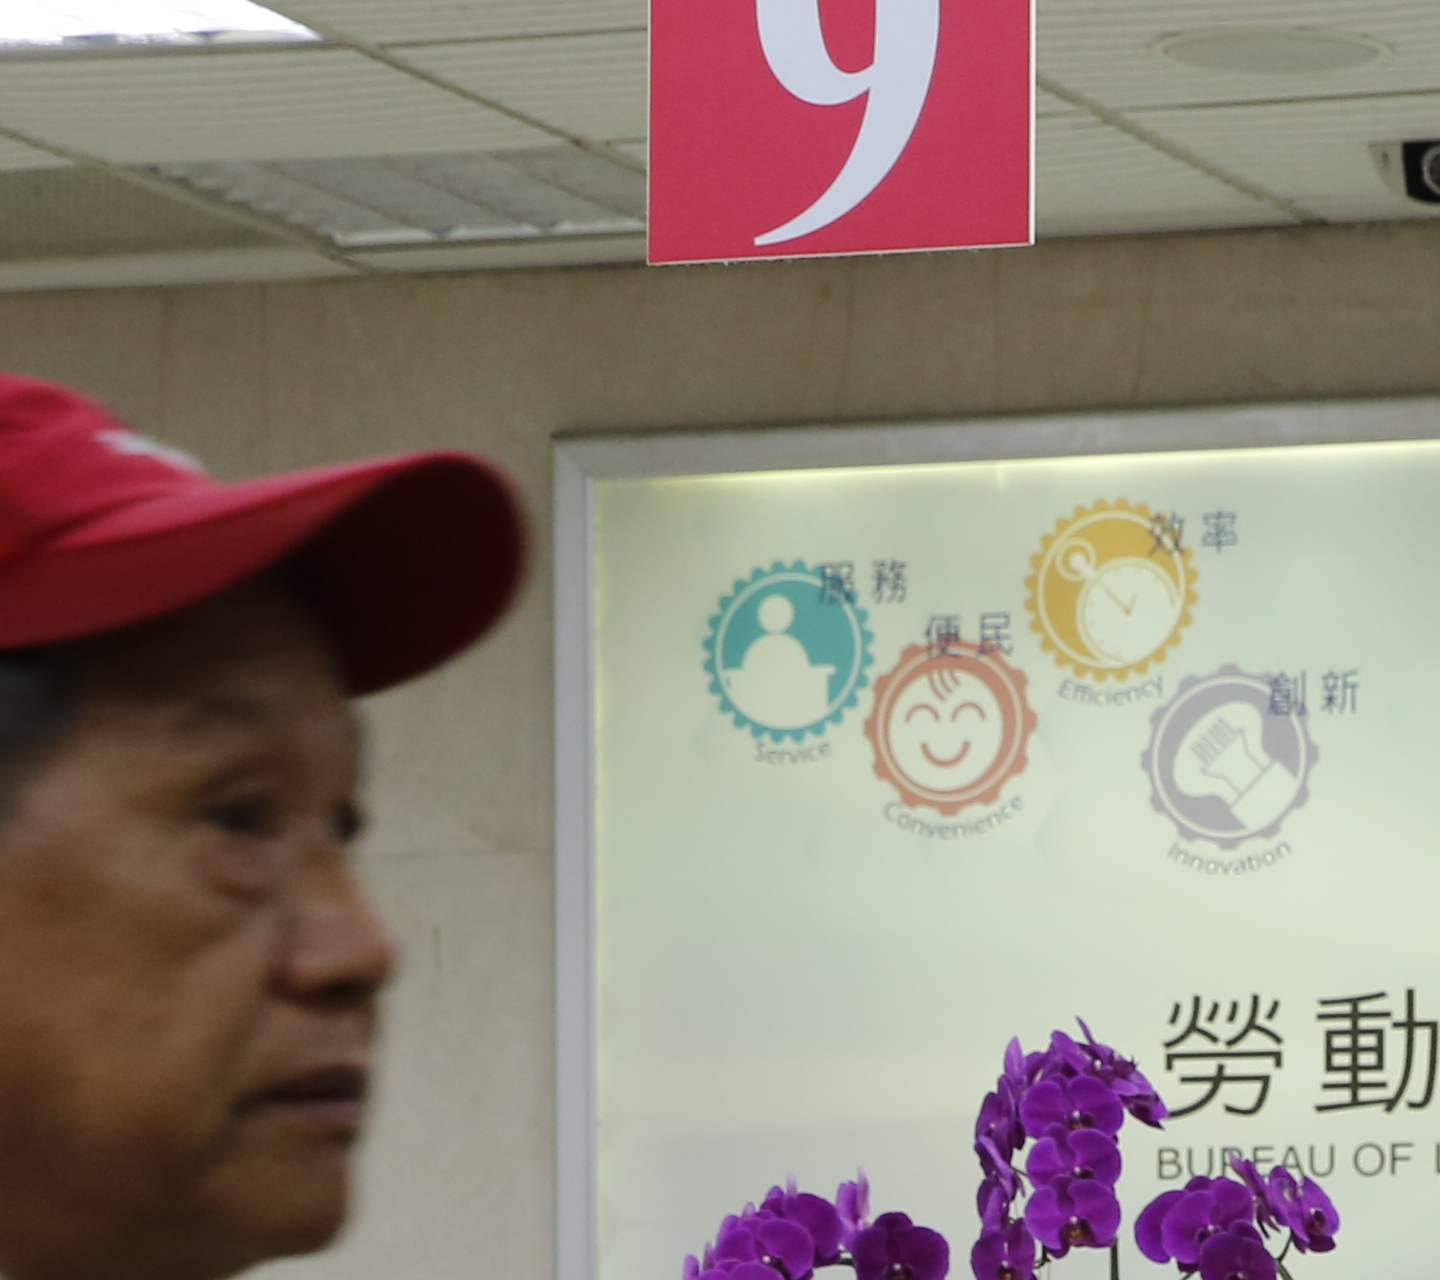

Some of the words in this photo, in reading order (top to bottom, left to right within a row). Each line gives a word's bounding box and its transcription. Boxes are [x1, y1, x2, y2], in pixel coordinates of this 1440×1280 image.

[754, 0, 940, 246] 9
[1149, 510, 1238, 555] 效率
[820, 559, 908, 604] 服務
[925, 611, 1013, 660] 便民
[1058, 674, 1164, 708] Efficiency
[1267, 669, 1360, 717] 創新
[754, 741, 832, 765] Service
[883, 795, 1024, 841] Convenience
[1166, 839, 1293, 876] Innovation
[1353, 1142, 1414, 1176] OF
